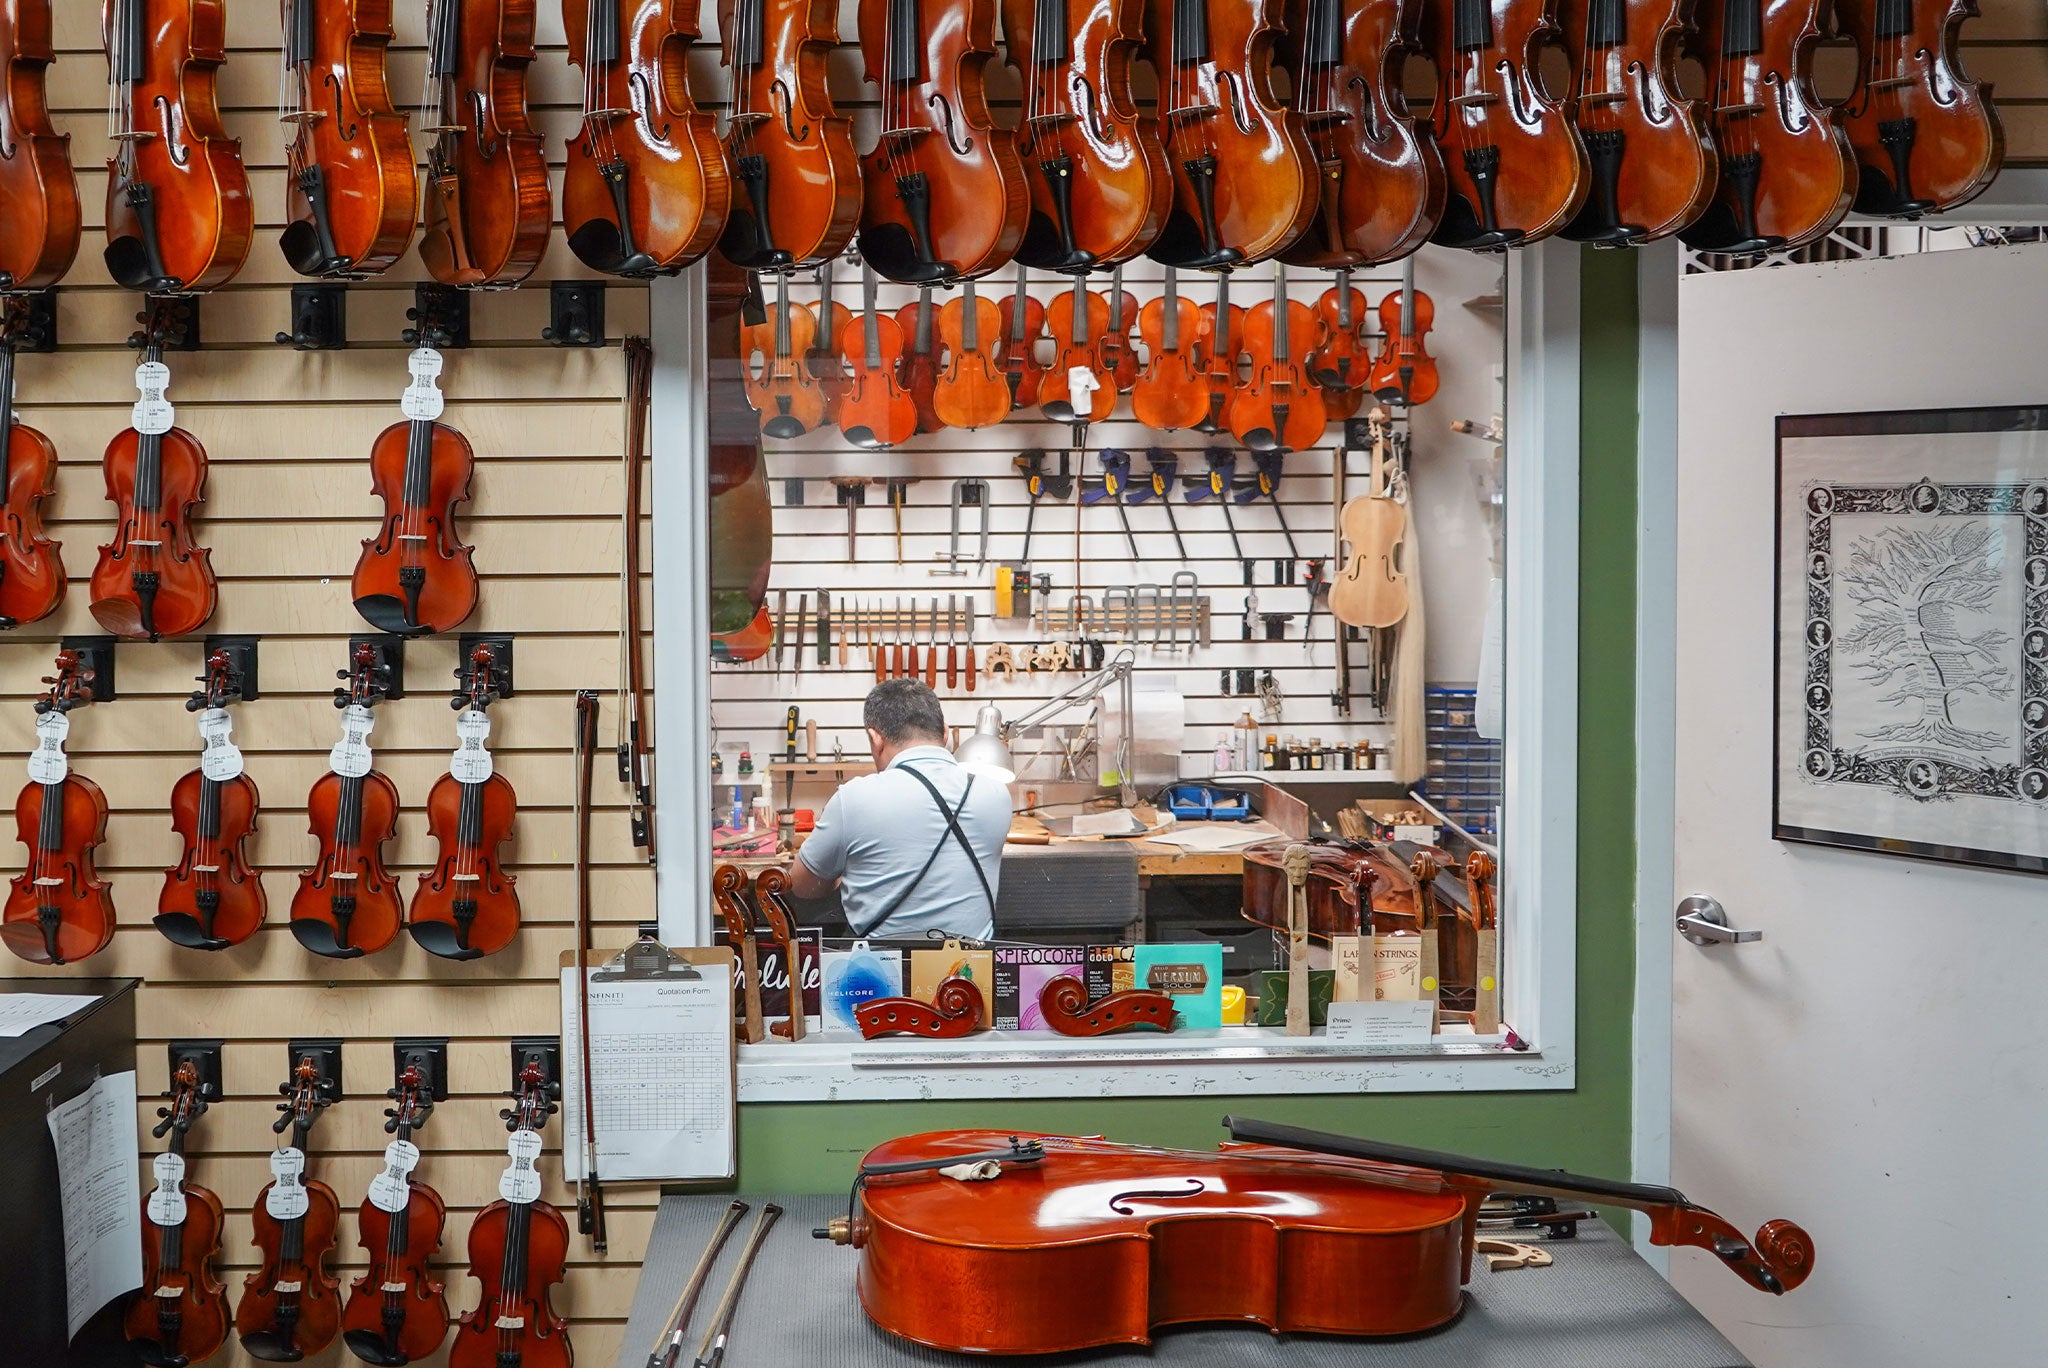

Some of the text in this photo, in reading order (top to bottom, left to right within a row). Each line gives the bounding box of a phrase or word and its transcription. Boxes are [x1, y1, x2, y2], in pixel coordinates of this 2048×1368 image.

[995, 949, 1083, 963] SPIROCORE
[1089, 953, 1113, 962] GOLD
[1154, 971, 1201, 983] VERSUM
[657, 987, 711, 996] Quotation Form
[827, 989, 874, 997] HELICORE
